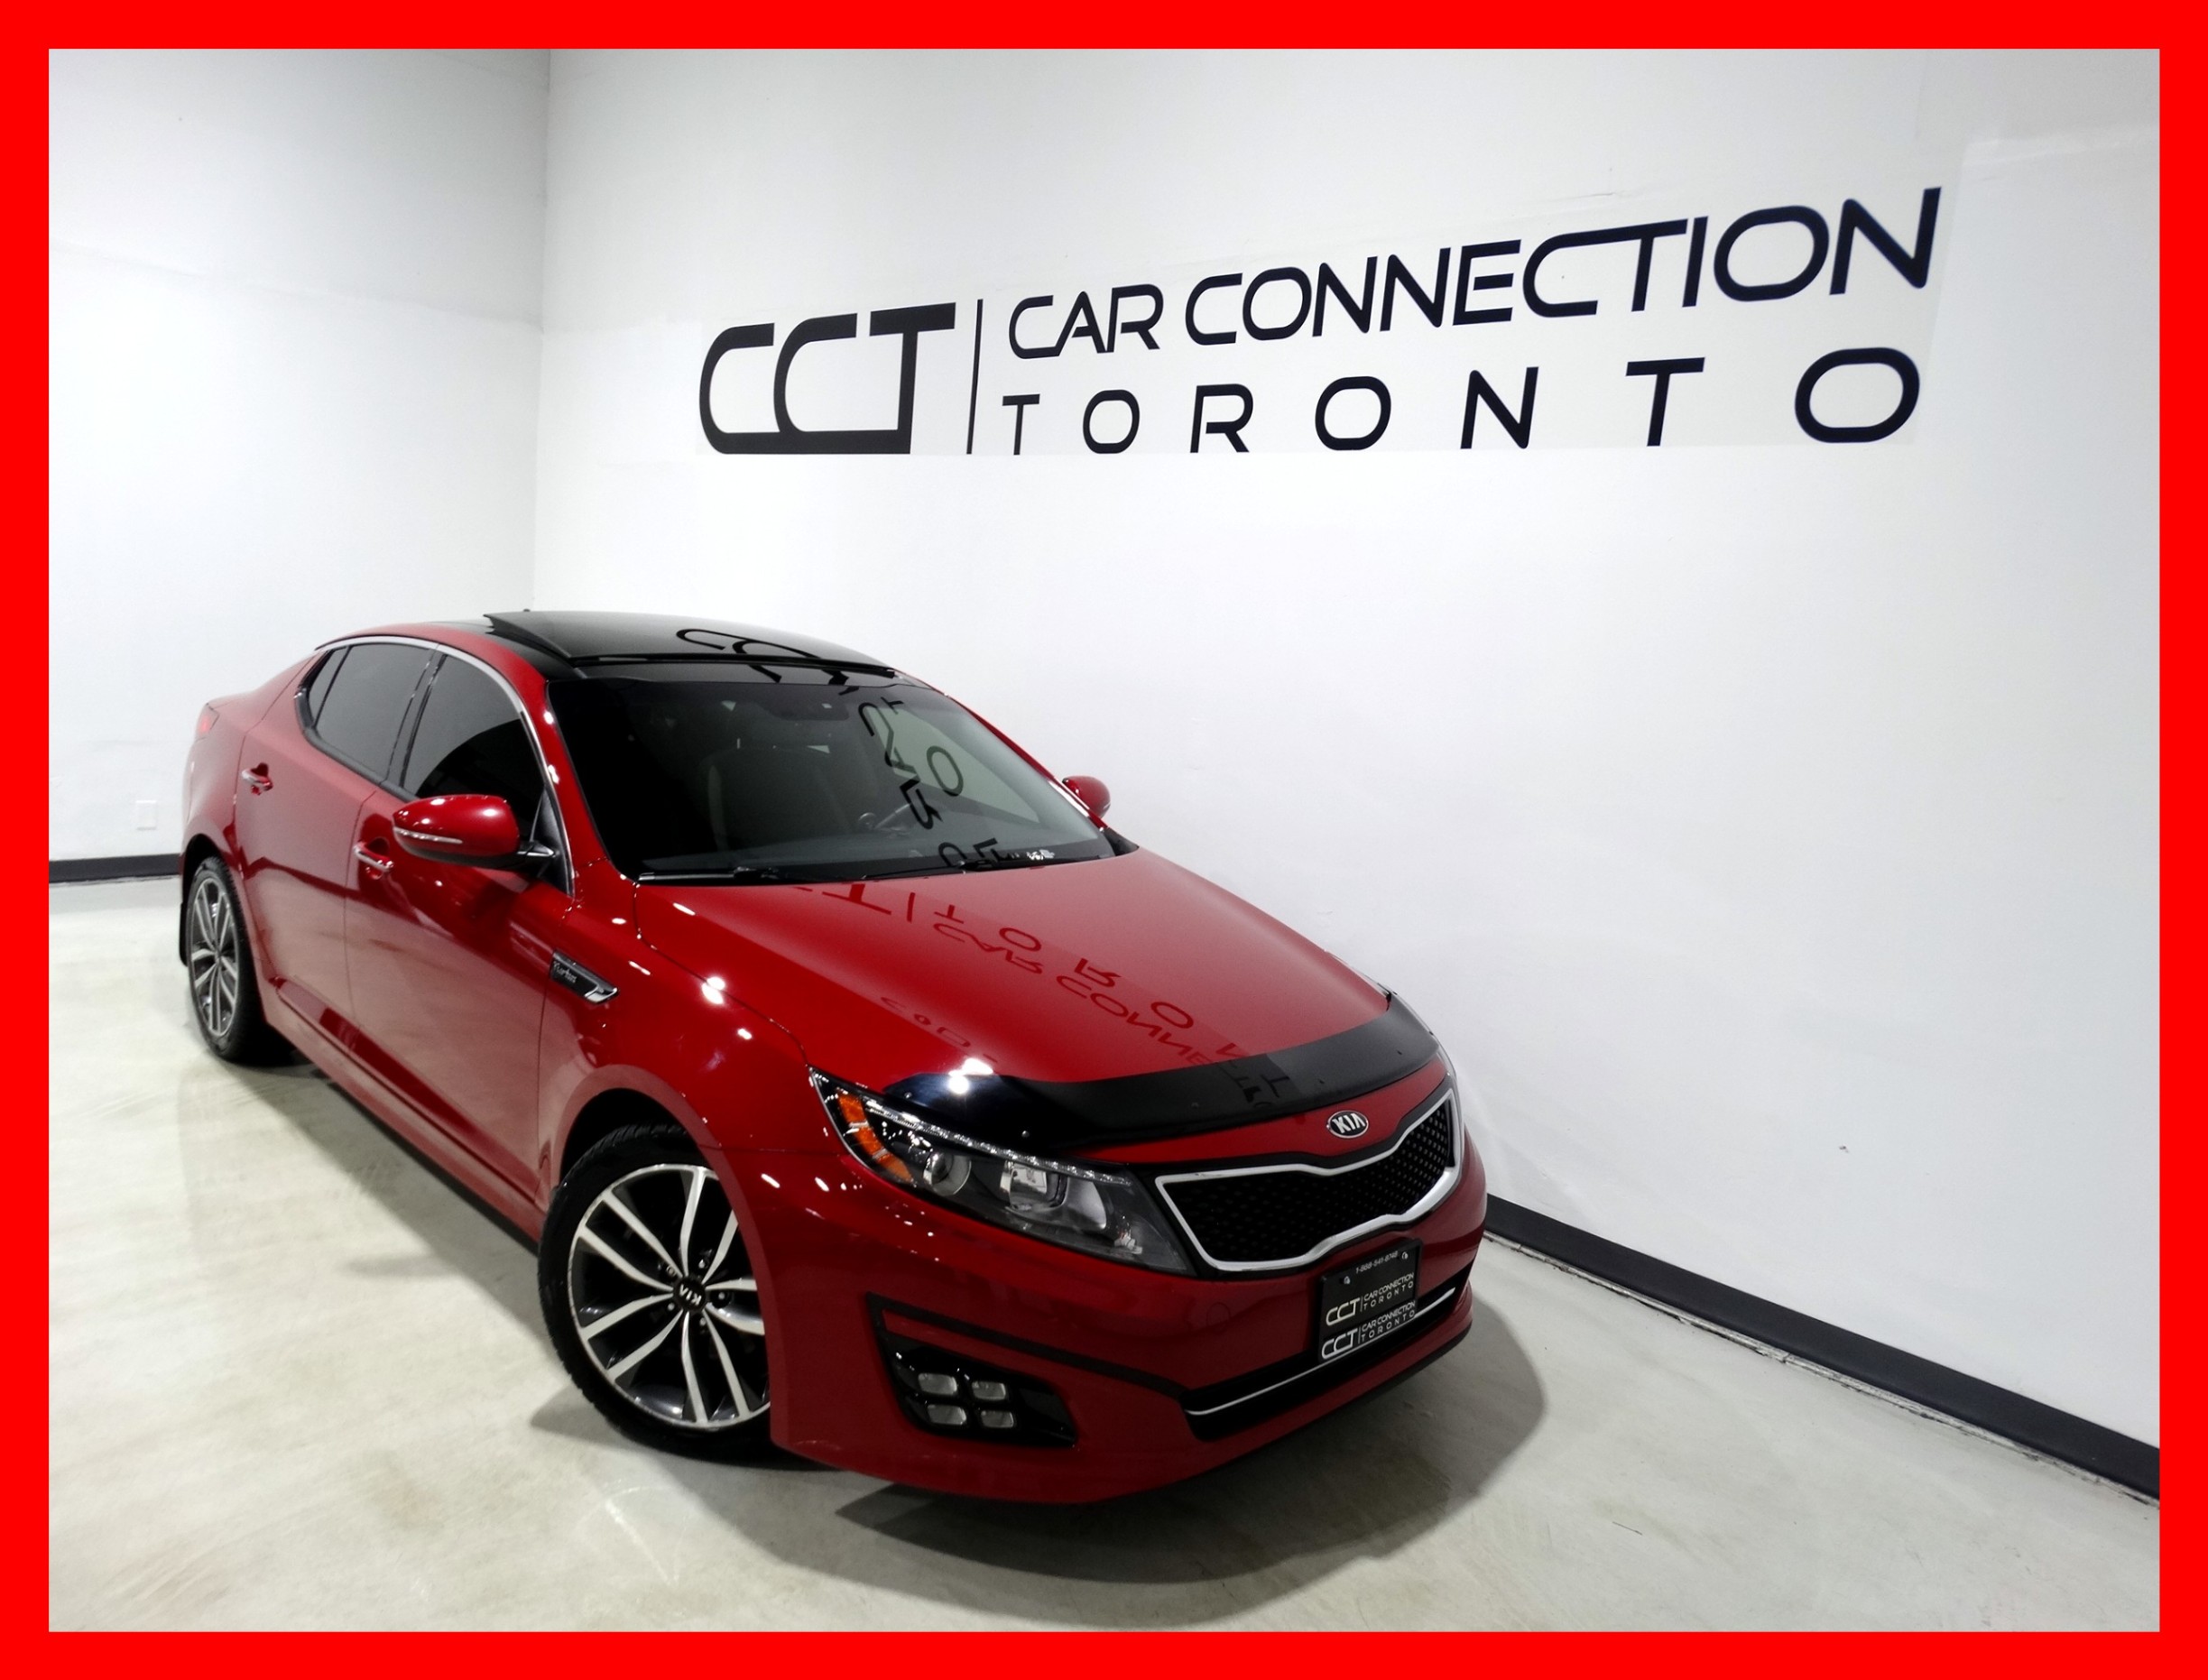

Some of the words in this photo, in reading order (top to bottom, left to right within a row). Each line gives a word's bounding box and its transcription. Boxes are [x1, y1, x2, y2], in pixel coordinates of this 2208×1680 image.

[1008, 283, 1164, 360] CAR
[1184, 186, 1943, 346] CONNECTION
[698, 302, 956, 455] CCT
[1001, 346, 1920, 456] TORONTO
[1332, 1112, 1366, 1134] KIA
[679, 1284, 702, 1306] KIA
[1363, 1280, 1414, 1310] TORONTO
[1364, 1289, 1379, 1301] CAR
[1378, 1272, 1414, 1295] CONNECTION
[1326, 1297, 1361, 1326] CCT
[1362, 1320, 1377, 1332] CAR
[1377, 1301, 1416, 1325] CONNECTION
[1362, 1310, 1415, 1342] TORONTO
[1321, 1327, 1358, 1360] CCT
